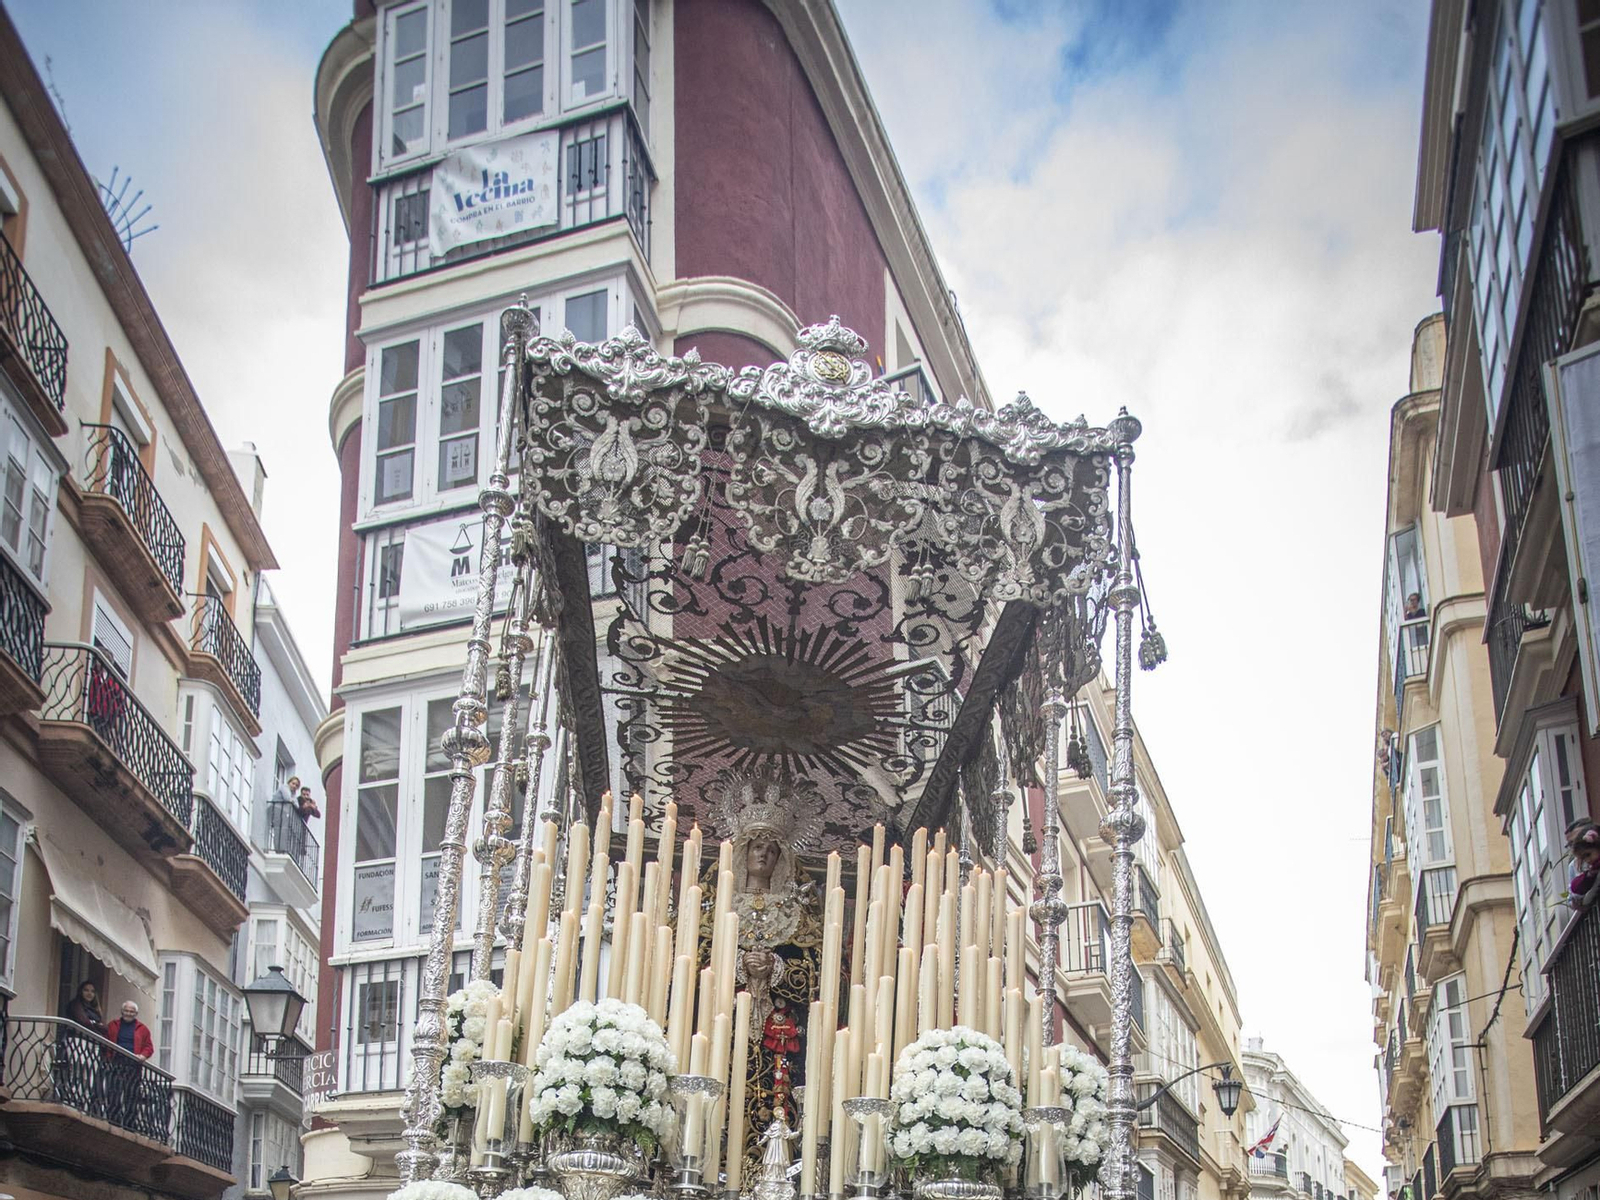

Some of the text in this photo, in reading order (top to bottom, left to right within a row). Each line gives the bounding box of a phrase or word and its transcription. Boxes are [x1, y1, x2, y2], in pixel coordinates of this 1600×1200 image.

[450, 209, 482, 224] COMPRA
[484, 205, 494, 214] EN
[506, 196, 535, 208] BARRIO
[451, 555, 470, 577] M
[424, 602, 439, 613] 691
[358, 868, 394, 880] FUNDACIÓN
[372, 903, 394, 912] FUFESS
[356, 927, 393, 938] FORMACIÓN
